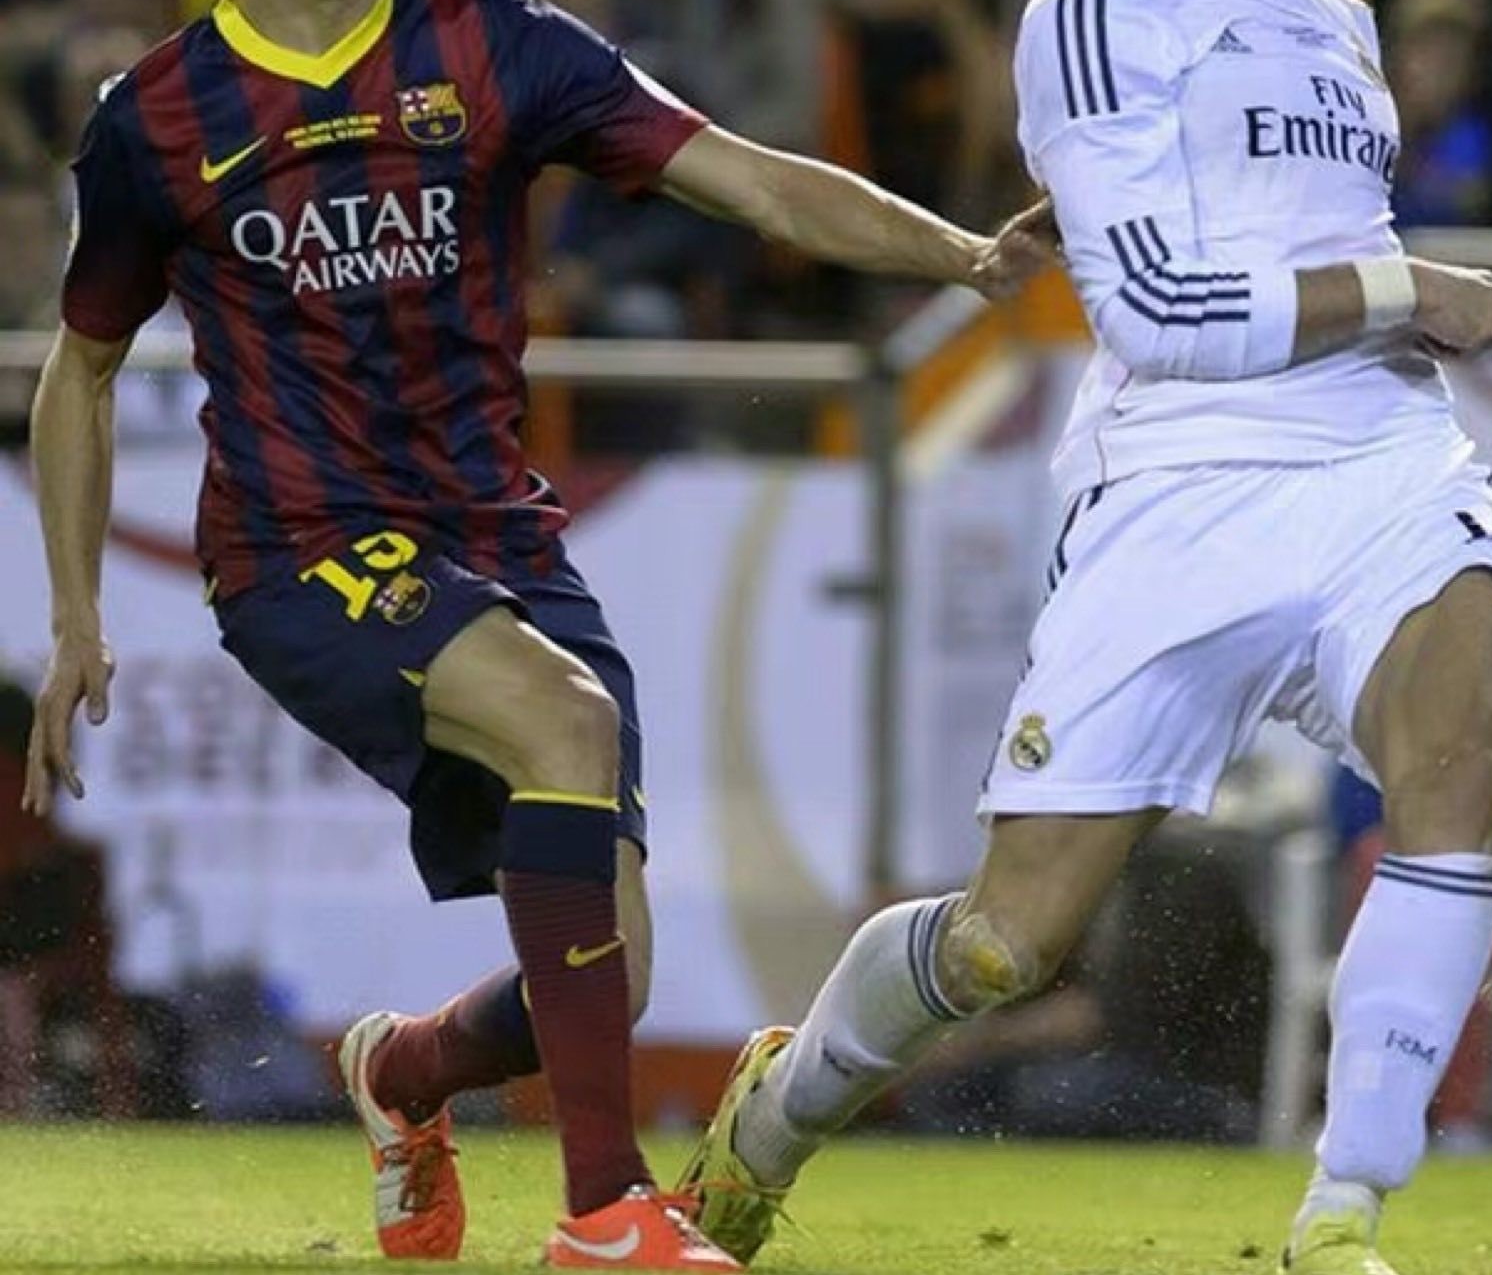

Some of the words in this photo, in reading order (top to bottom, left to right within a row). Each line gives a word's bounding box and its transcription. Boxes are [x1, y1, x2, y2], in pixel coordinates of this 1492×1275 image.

[1310, 75, 1366, 120] Fly
[1244, 105, 1397, 184] Emirate
[231, 184, 457, 271] QATAR
[293, 239, 460, 296] AIRWAYS
